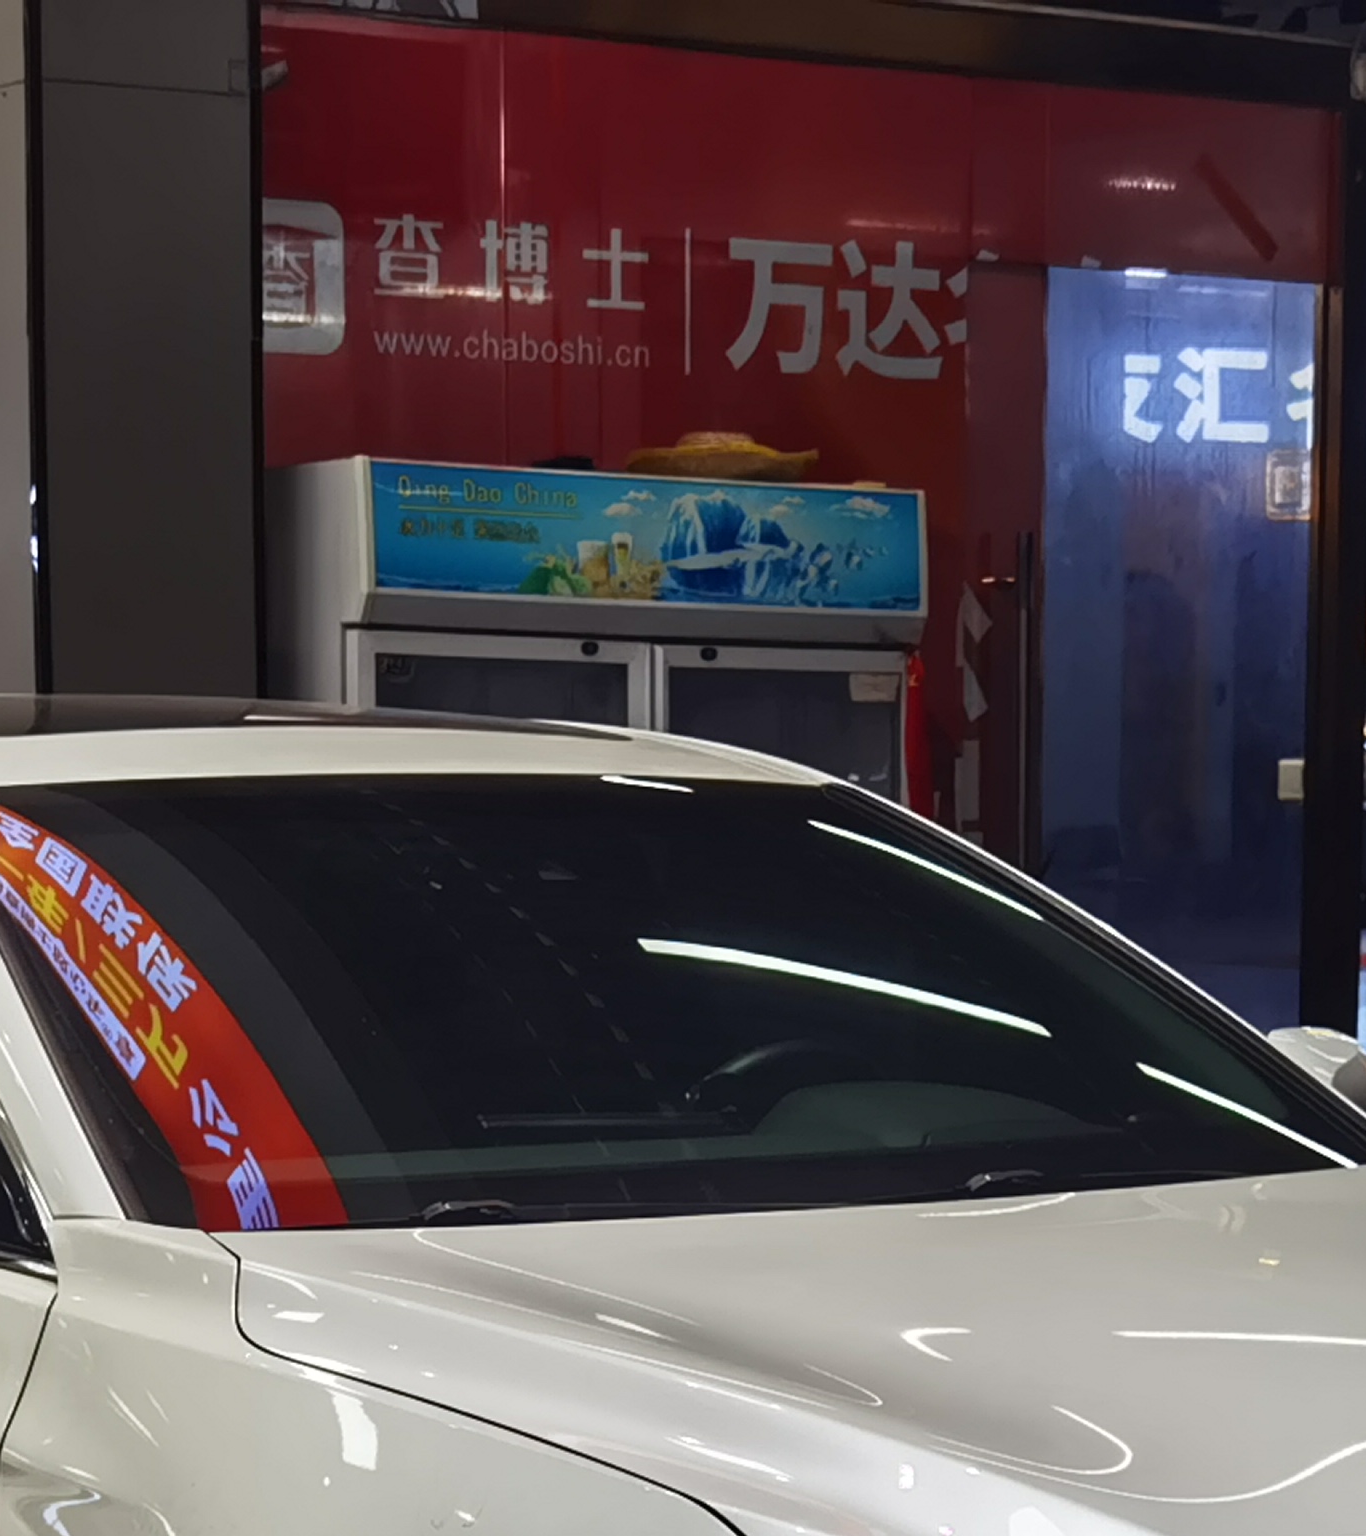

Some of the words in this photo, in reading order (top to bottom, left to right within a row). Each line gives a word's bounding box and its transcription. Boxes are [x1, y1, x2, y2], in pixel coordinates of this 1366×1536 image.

[373, 213, 649, 311] 查博士
[725, 236, 969, 380] 万达
[373, 329, 651, 368] www.chaboshi.cn
[463, 479, 502, 504] Dao
[514, 482, 579, 508] China
